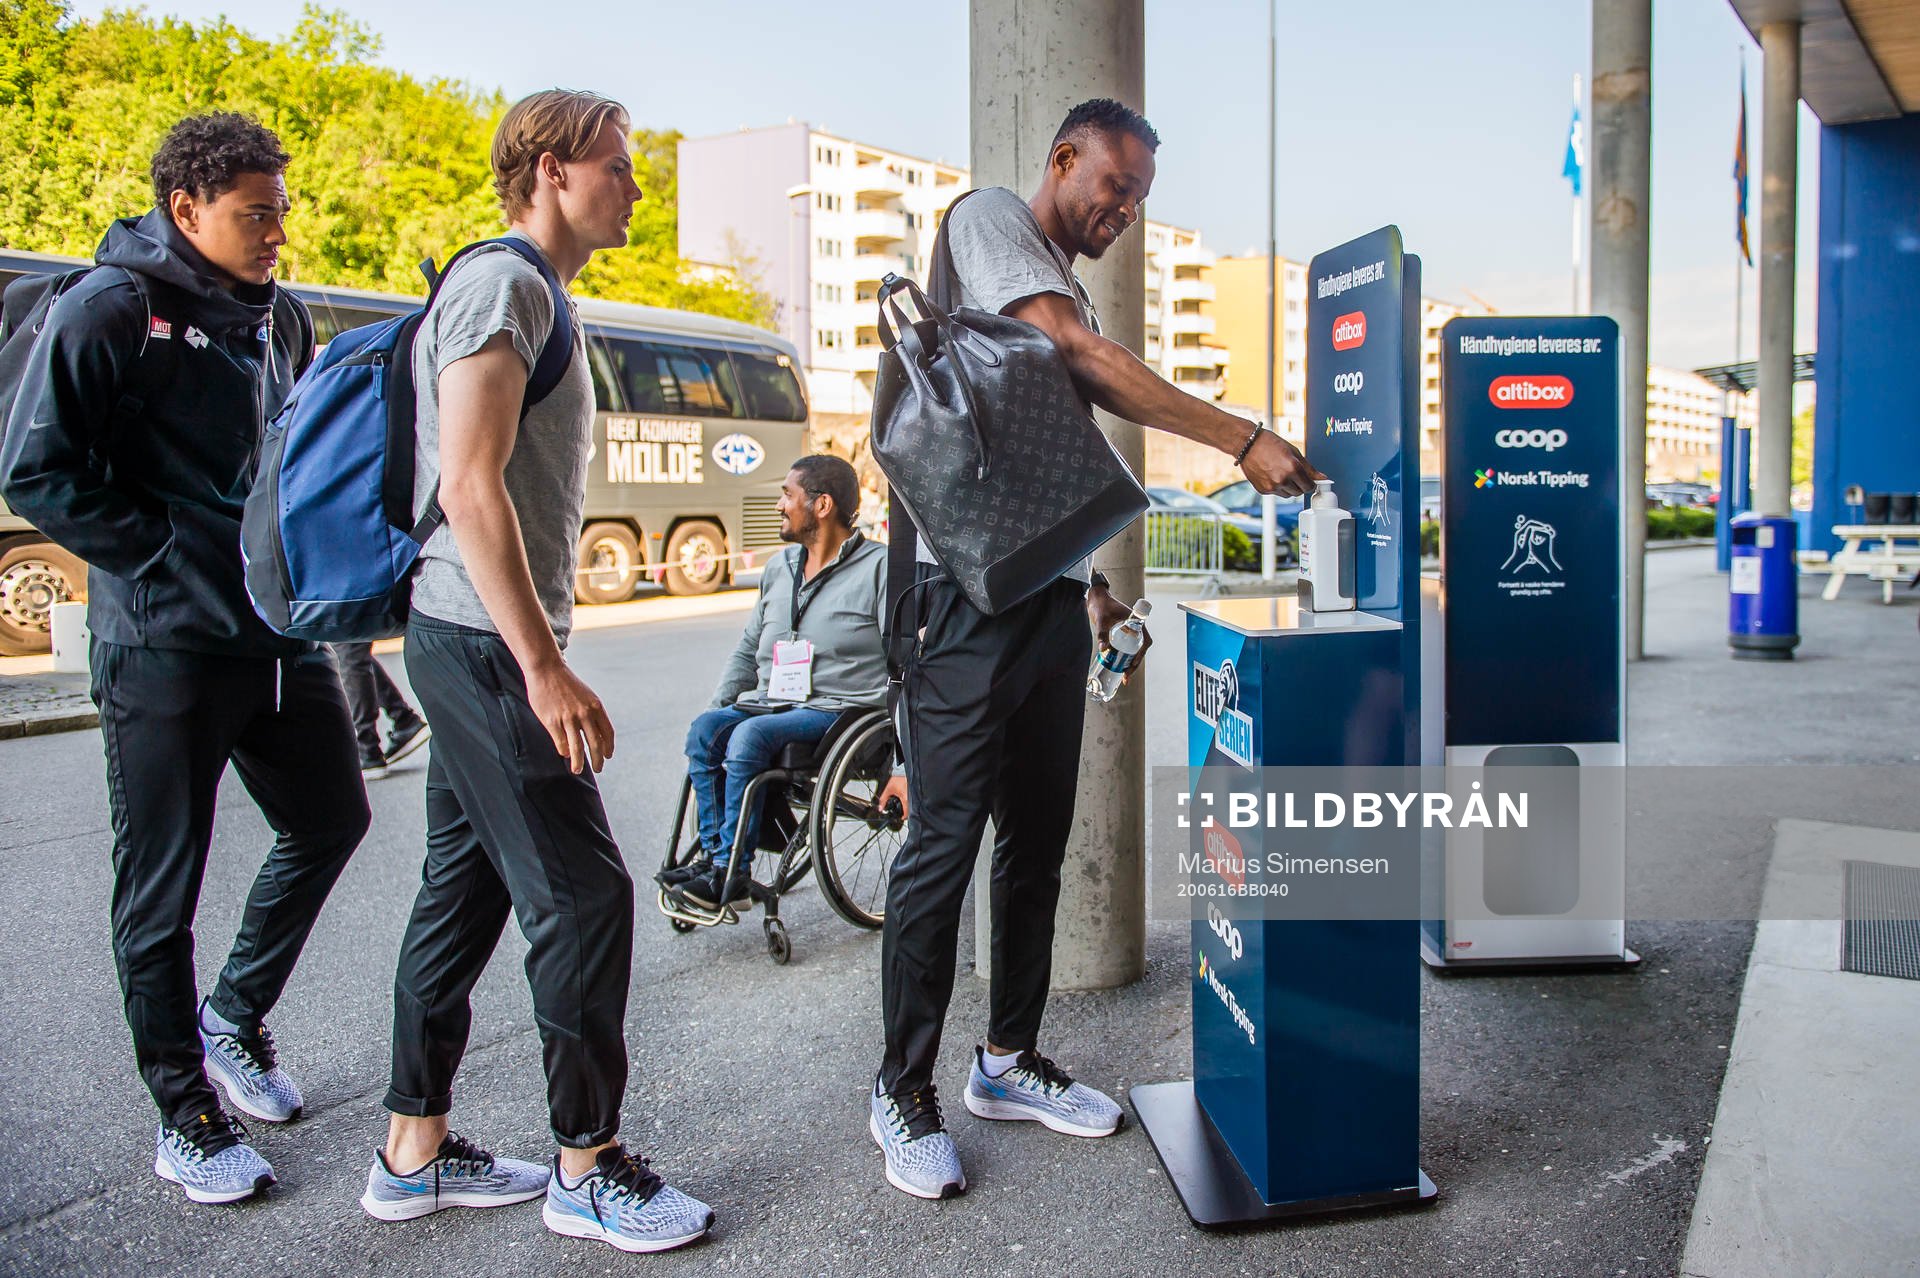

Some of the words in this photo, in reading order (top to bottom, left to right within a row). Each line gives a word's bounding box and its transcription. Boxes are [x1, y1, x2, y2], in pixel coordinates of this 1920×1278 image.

[1352, 265, 1375, 288] leveres
[155, 321, 171, 332] MOT
[1335, 321, 1363, 342] altibox
[1460, 335, 1537, 356] Håndhygiene
[1538, 335, 1582, 353] leveres
[1334, 371, 1363, 395] coop
[1496, 381, 1565, 401] altibox
[606, 416, 639, 441] HER
[640, 418, 704, 444] KOMMER
[1334, 418, 1351, 433] Norsk
[1350, 416, 1373, 435] Tipping
[1494, 428, 1568, 452] coop
[607, 440, 704, 484] MOLDE
[1497, 470, 1538, 486] Norsk
[1537, 470, 1590, 488] Tipping
[1195, 667, 1220, 723] ELITE
[1219, 708, 1251, 763] SERIEN
[1207, 901, 1243, 961] coop
[1209, 965, 1229, 1008] Norsk
[1227, 989, 1255, 1045] Tipping
